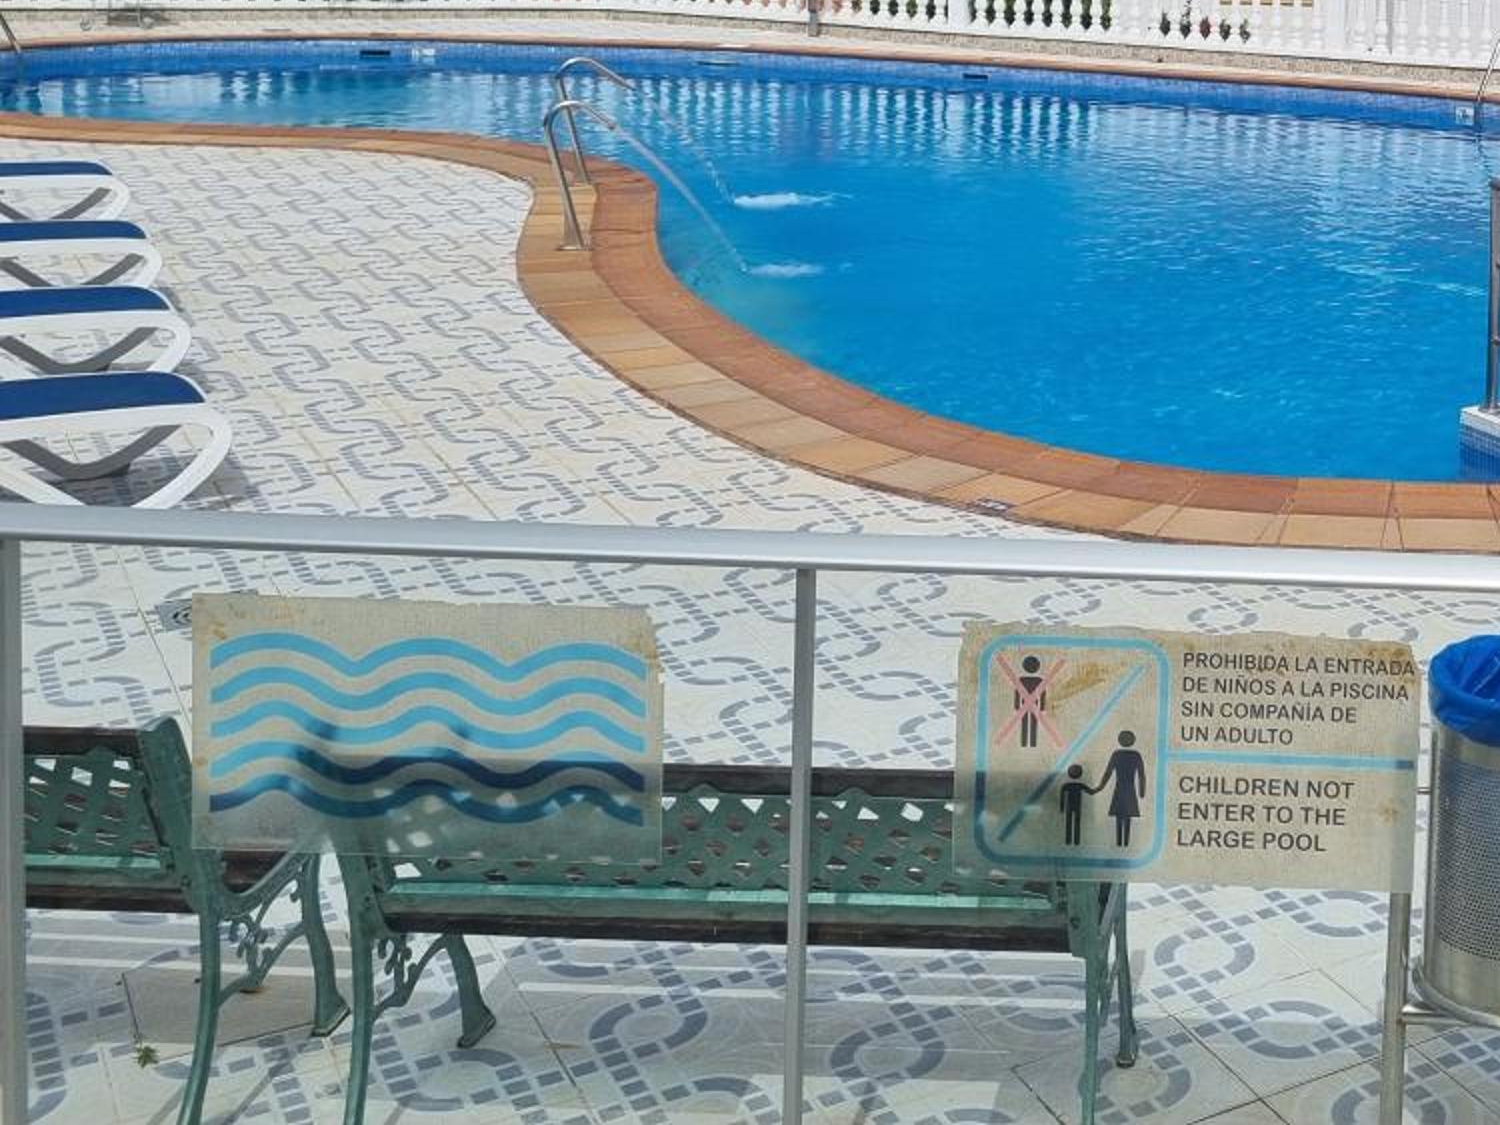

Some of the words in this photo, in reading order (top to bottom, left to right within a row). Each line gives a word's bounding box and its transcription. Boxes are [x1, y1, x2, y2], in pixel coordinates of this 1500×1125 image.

[1183, 652, 1290, 673] PROHIBIDA
[1295, 657, 1319, 674] LA
[1324, 657, 1416, 676] ENTRADA
[1182, 676, 1209, 694] DE
[1214, 675, 1276, 696] NIÑOS
[1281, 680, 1295, 697] A
[1300, 681, 1325, 698] LA
[1330, 682, 1410, 701] PISCINA
[1181, 701, 1214, 718] SIN
[1330, 706, 1358, 724] DE
[1180, 726, 1209, 743] UN
[1213, 726, 1294, 746] ADULTO
[1178, 775, 1299, 798] CHILDREN
[1306, 780, 1355, 799] NOT
[1177, 802, 1256, 823] ENTER
[1262, 805, 1294, 824] TO
[1300, 807, 1347, 826] THE
[1176, 828, 1255, 850] LARGE
[1262, 832, 1328, 852] POOL
